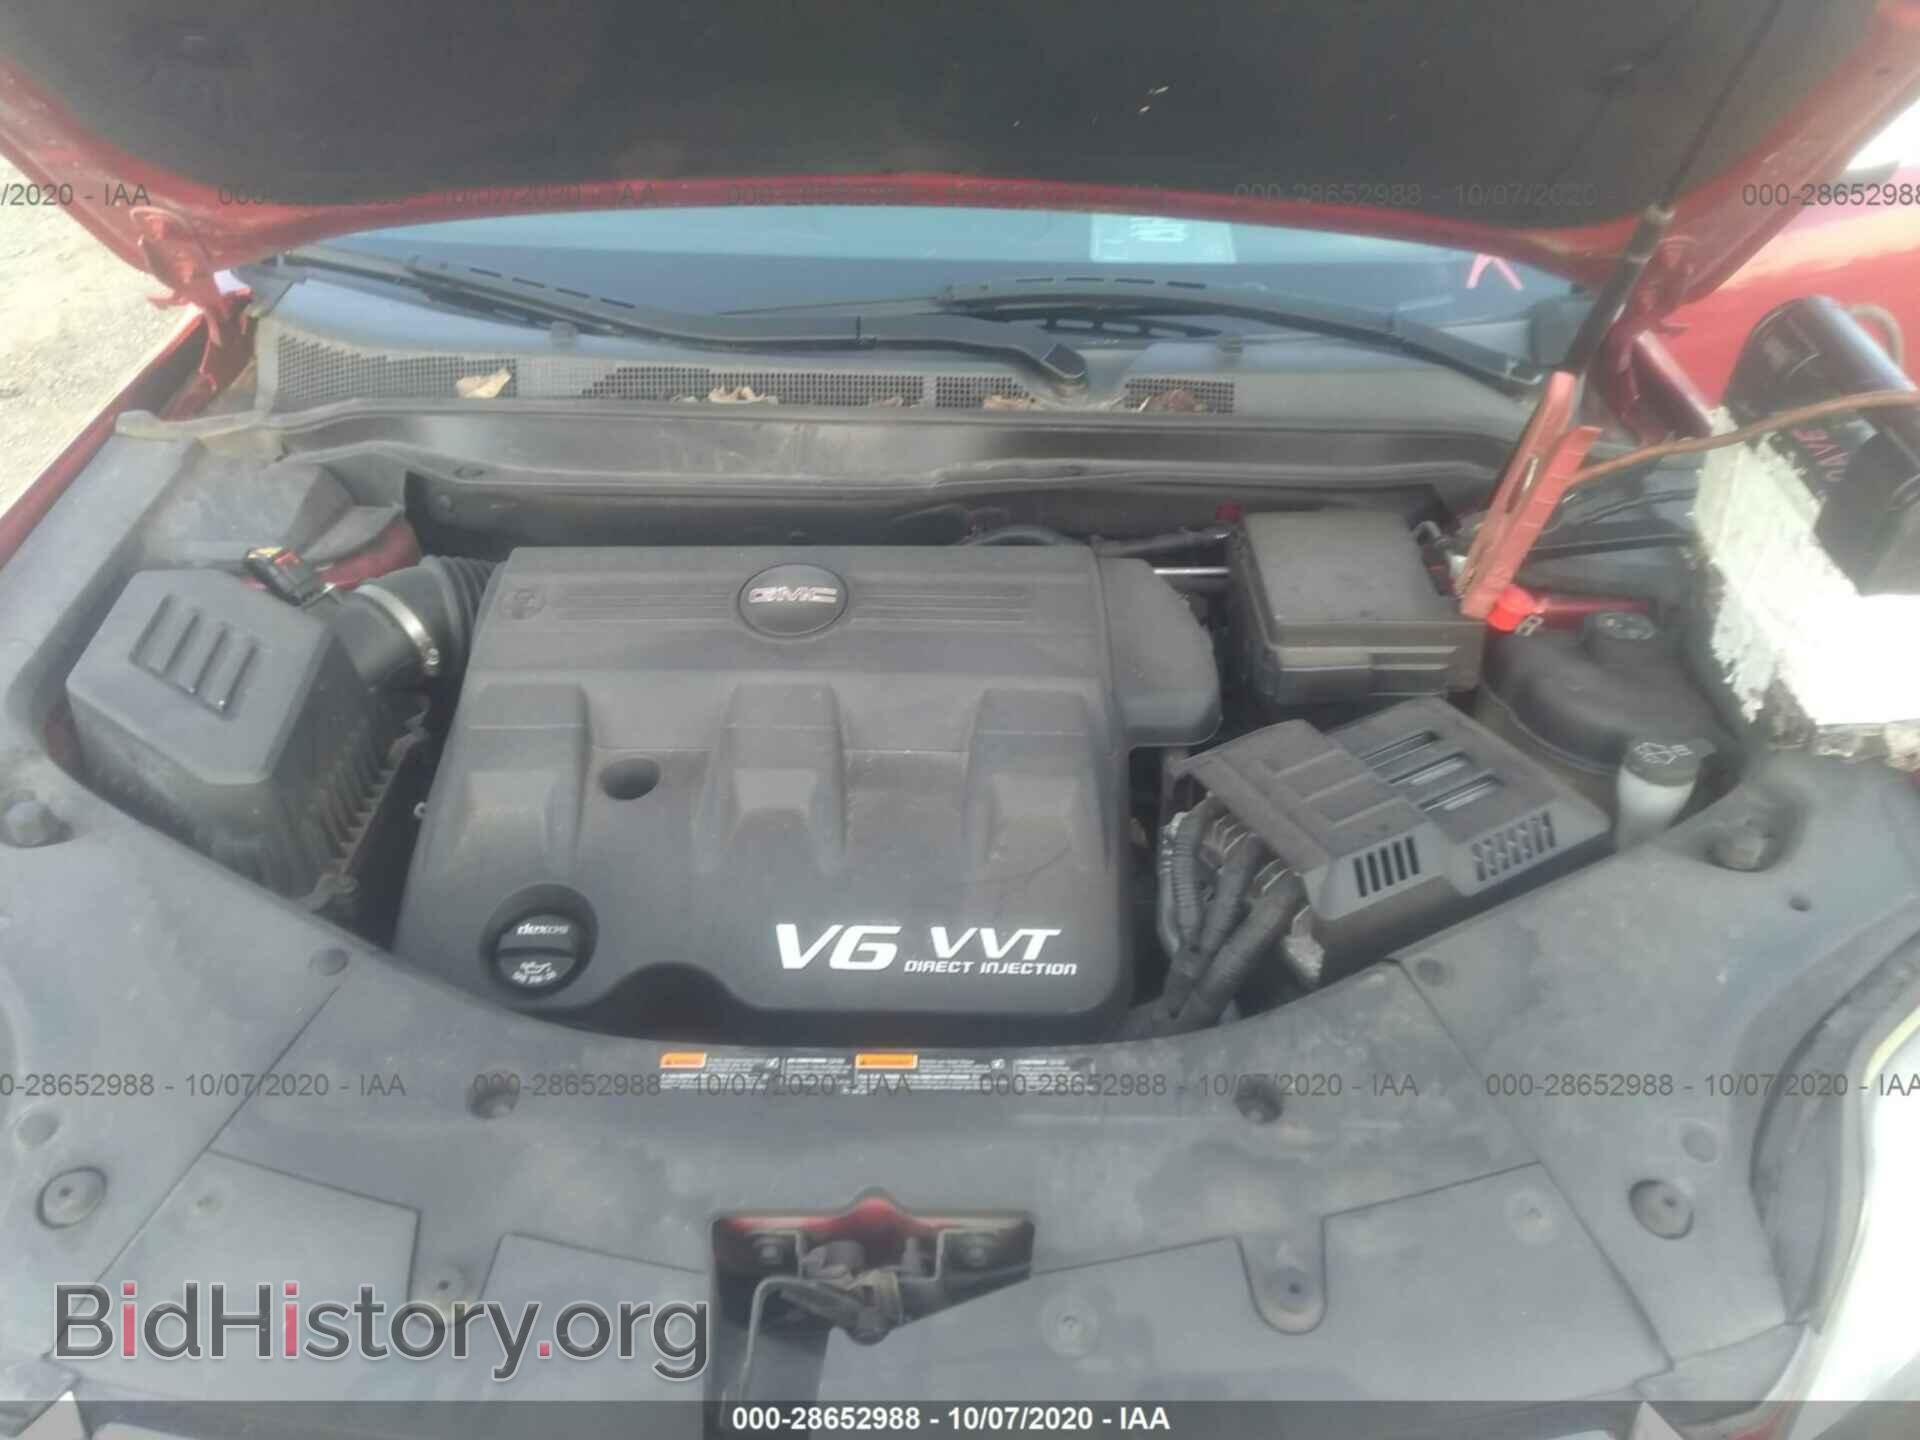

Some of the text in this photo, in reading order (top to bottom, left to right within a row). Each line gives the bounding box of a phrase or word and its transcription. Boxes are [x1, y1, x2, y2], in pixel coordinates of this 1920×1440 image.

[748, 586, 837, 603] GMC
[775, 923, 1061, 970] V6 VVT
[904, 960, 1078, 975] DIRECT INJECTION
